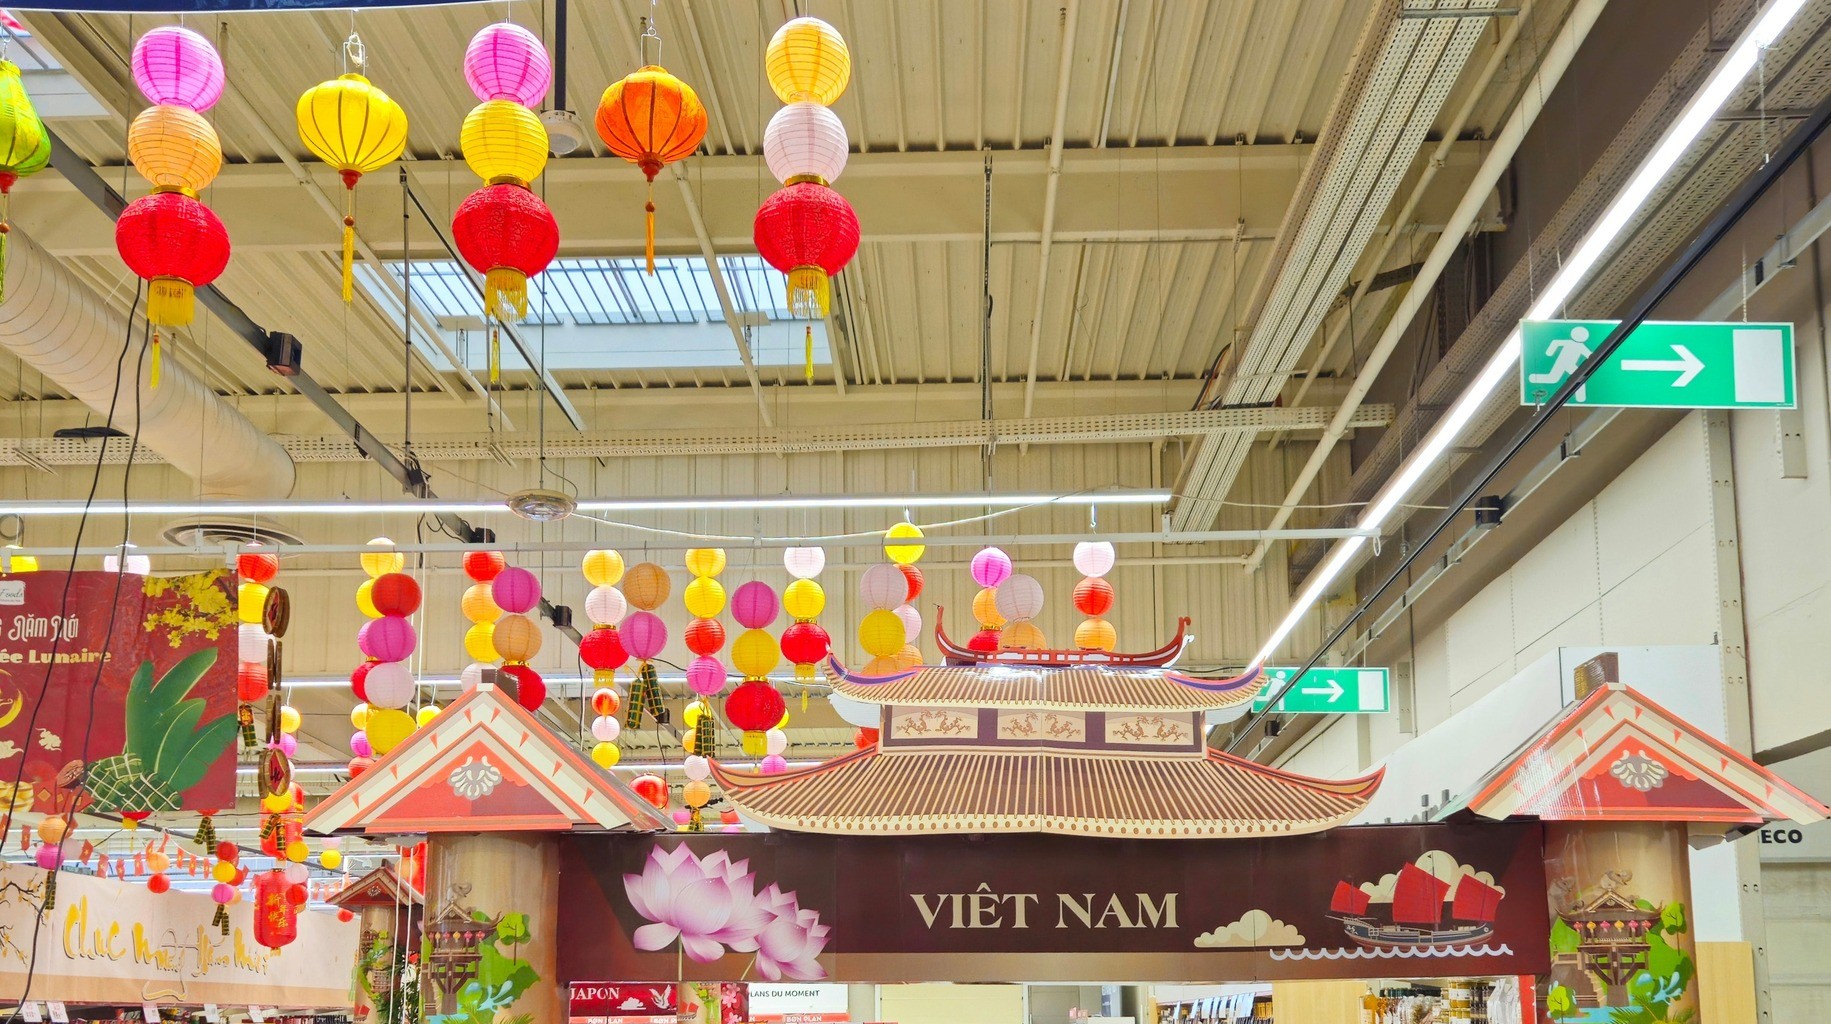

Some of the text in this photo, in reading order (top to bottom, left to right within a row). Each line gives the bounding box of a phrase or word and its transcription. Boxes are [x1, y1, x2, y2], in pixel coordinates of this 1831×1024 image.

[0, 648, 112, 663] ée Lunaire
[1761, 829, 1803, 844] ECO
[910, 882, 1180, 929] VIÊT NAM
[570, 987, 620, 1000] JAPON
[785, 989, 820, 997] MOMENT
